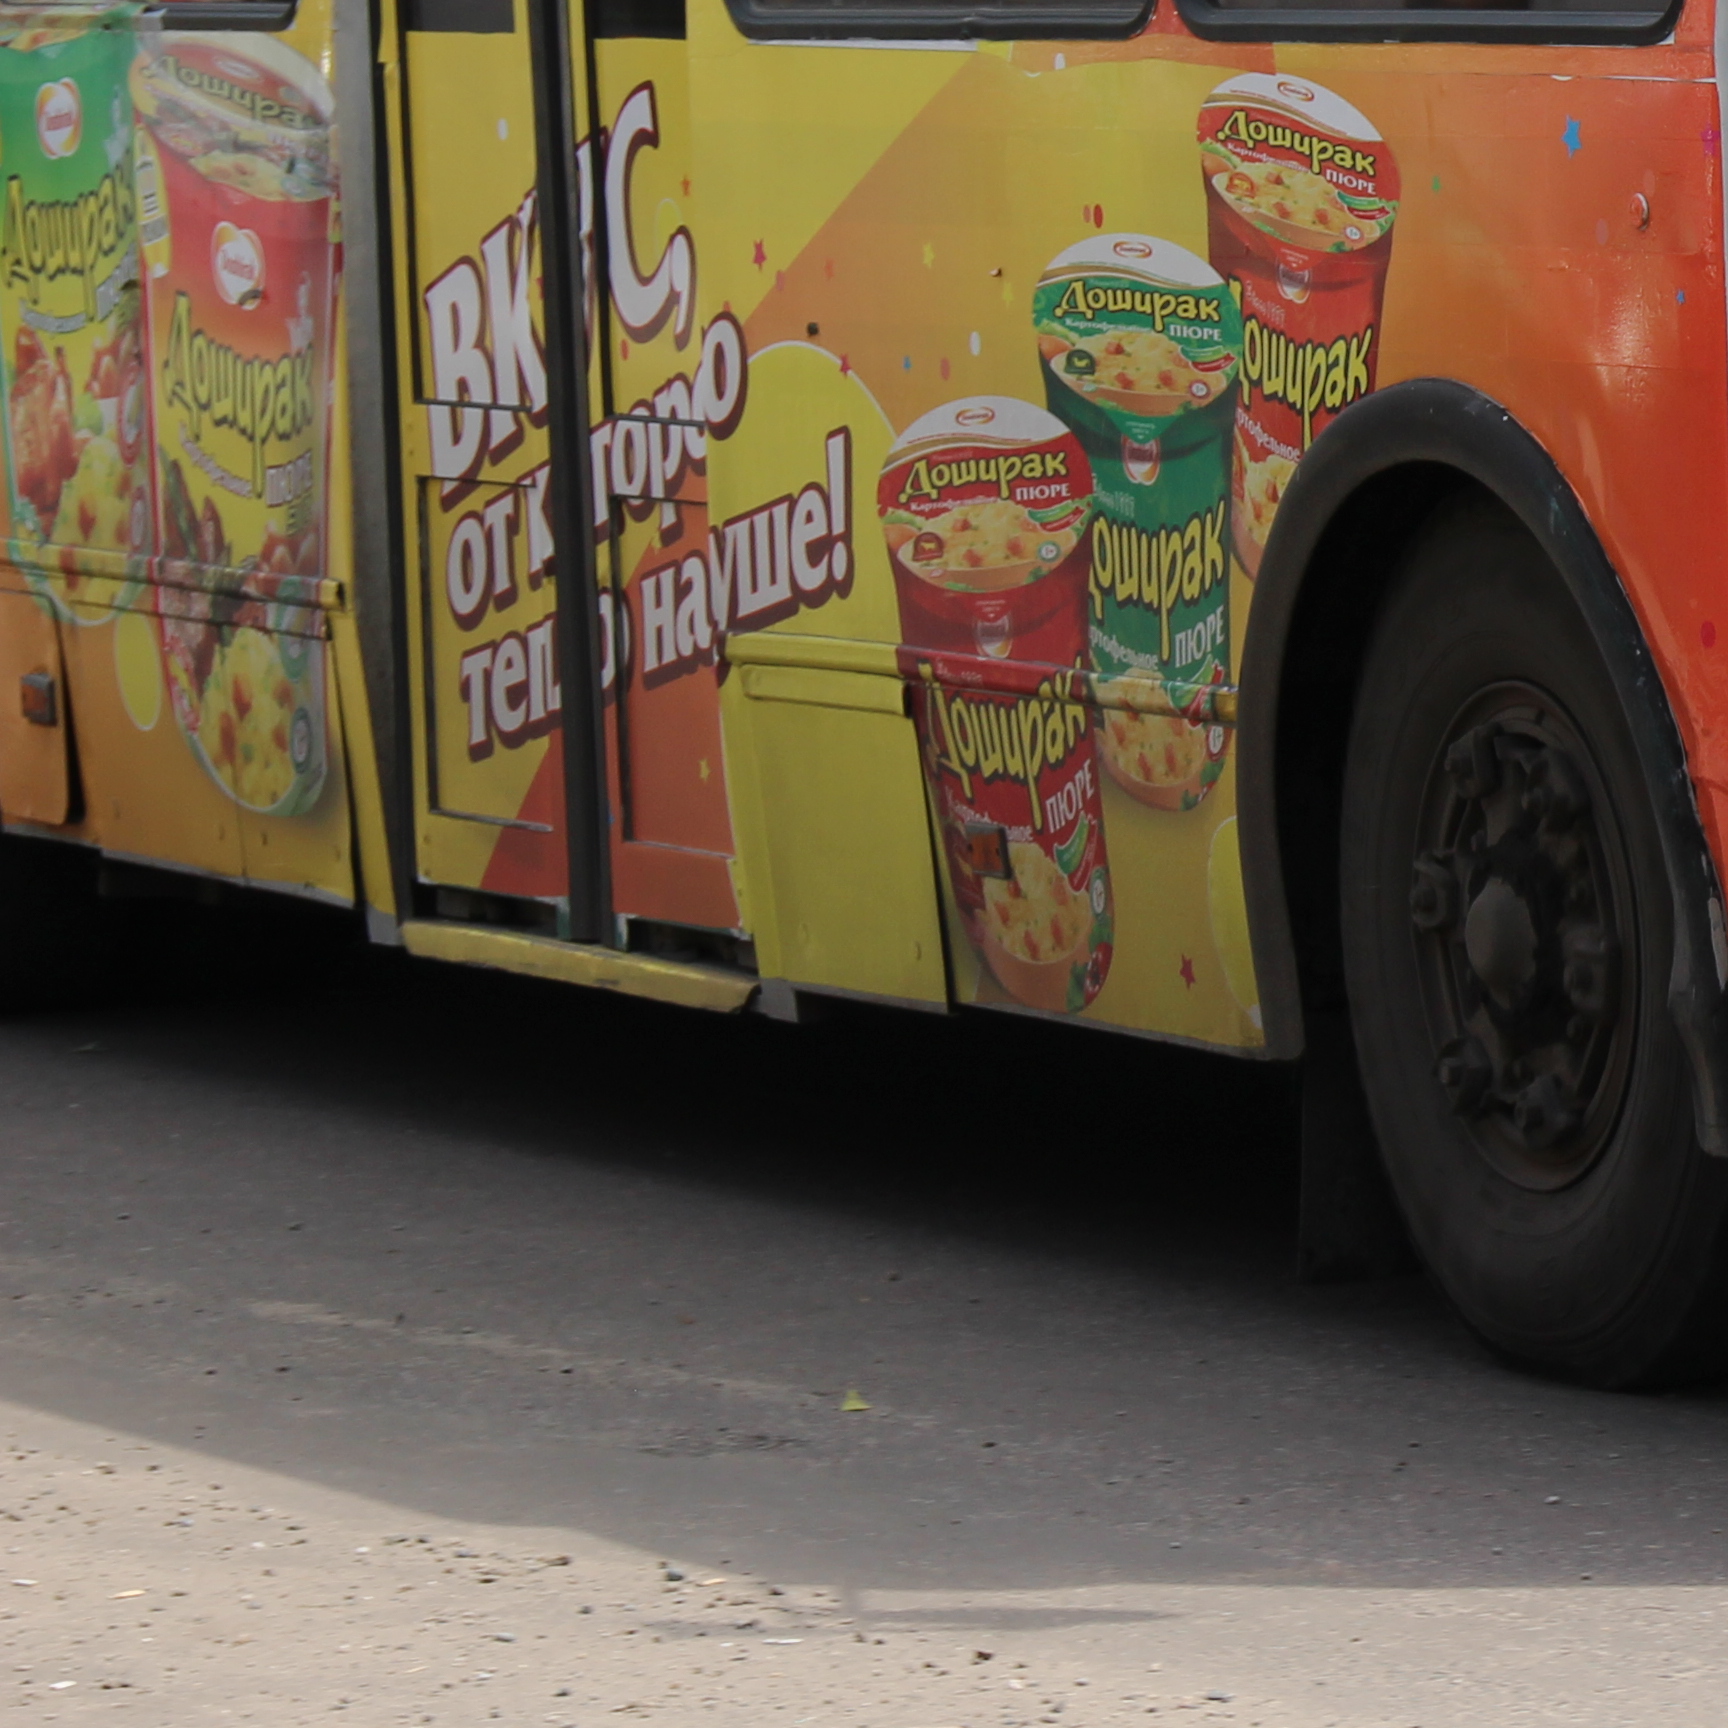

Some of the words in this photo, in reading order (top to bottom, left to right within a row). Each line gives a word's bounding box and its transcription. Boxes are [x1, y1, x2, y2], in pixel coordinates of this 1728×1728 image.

[1215, 109, 1376, 176] Доширак
[1325, 168, 1377, 195] ПЮРЕ
[1053, 279, 1221, 333] Доширак
[1169, 323, 1223, 343] ПЮРЕ
[897, 450, 1069, 504] Доширак
[1015, 482, 1072, 501] ПЮРЕ
[1088, 495, 1226, 665] оширак
[1174, 605, 1226, 668] ПЮРЕ
[917, 650, 1087, 833] Доширак
[1045, 758, 1096, 834] ПЮРЕ
